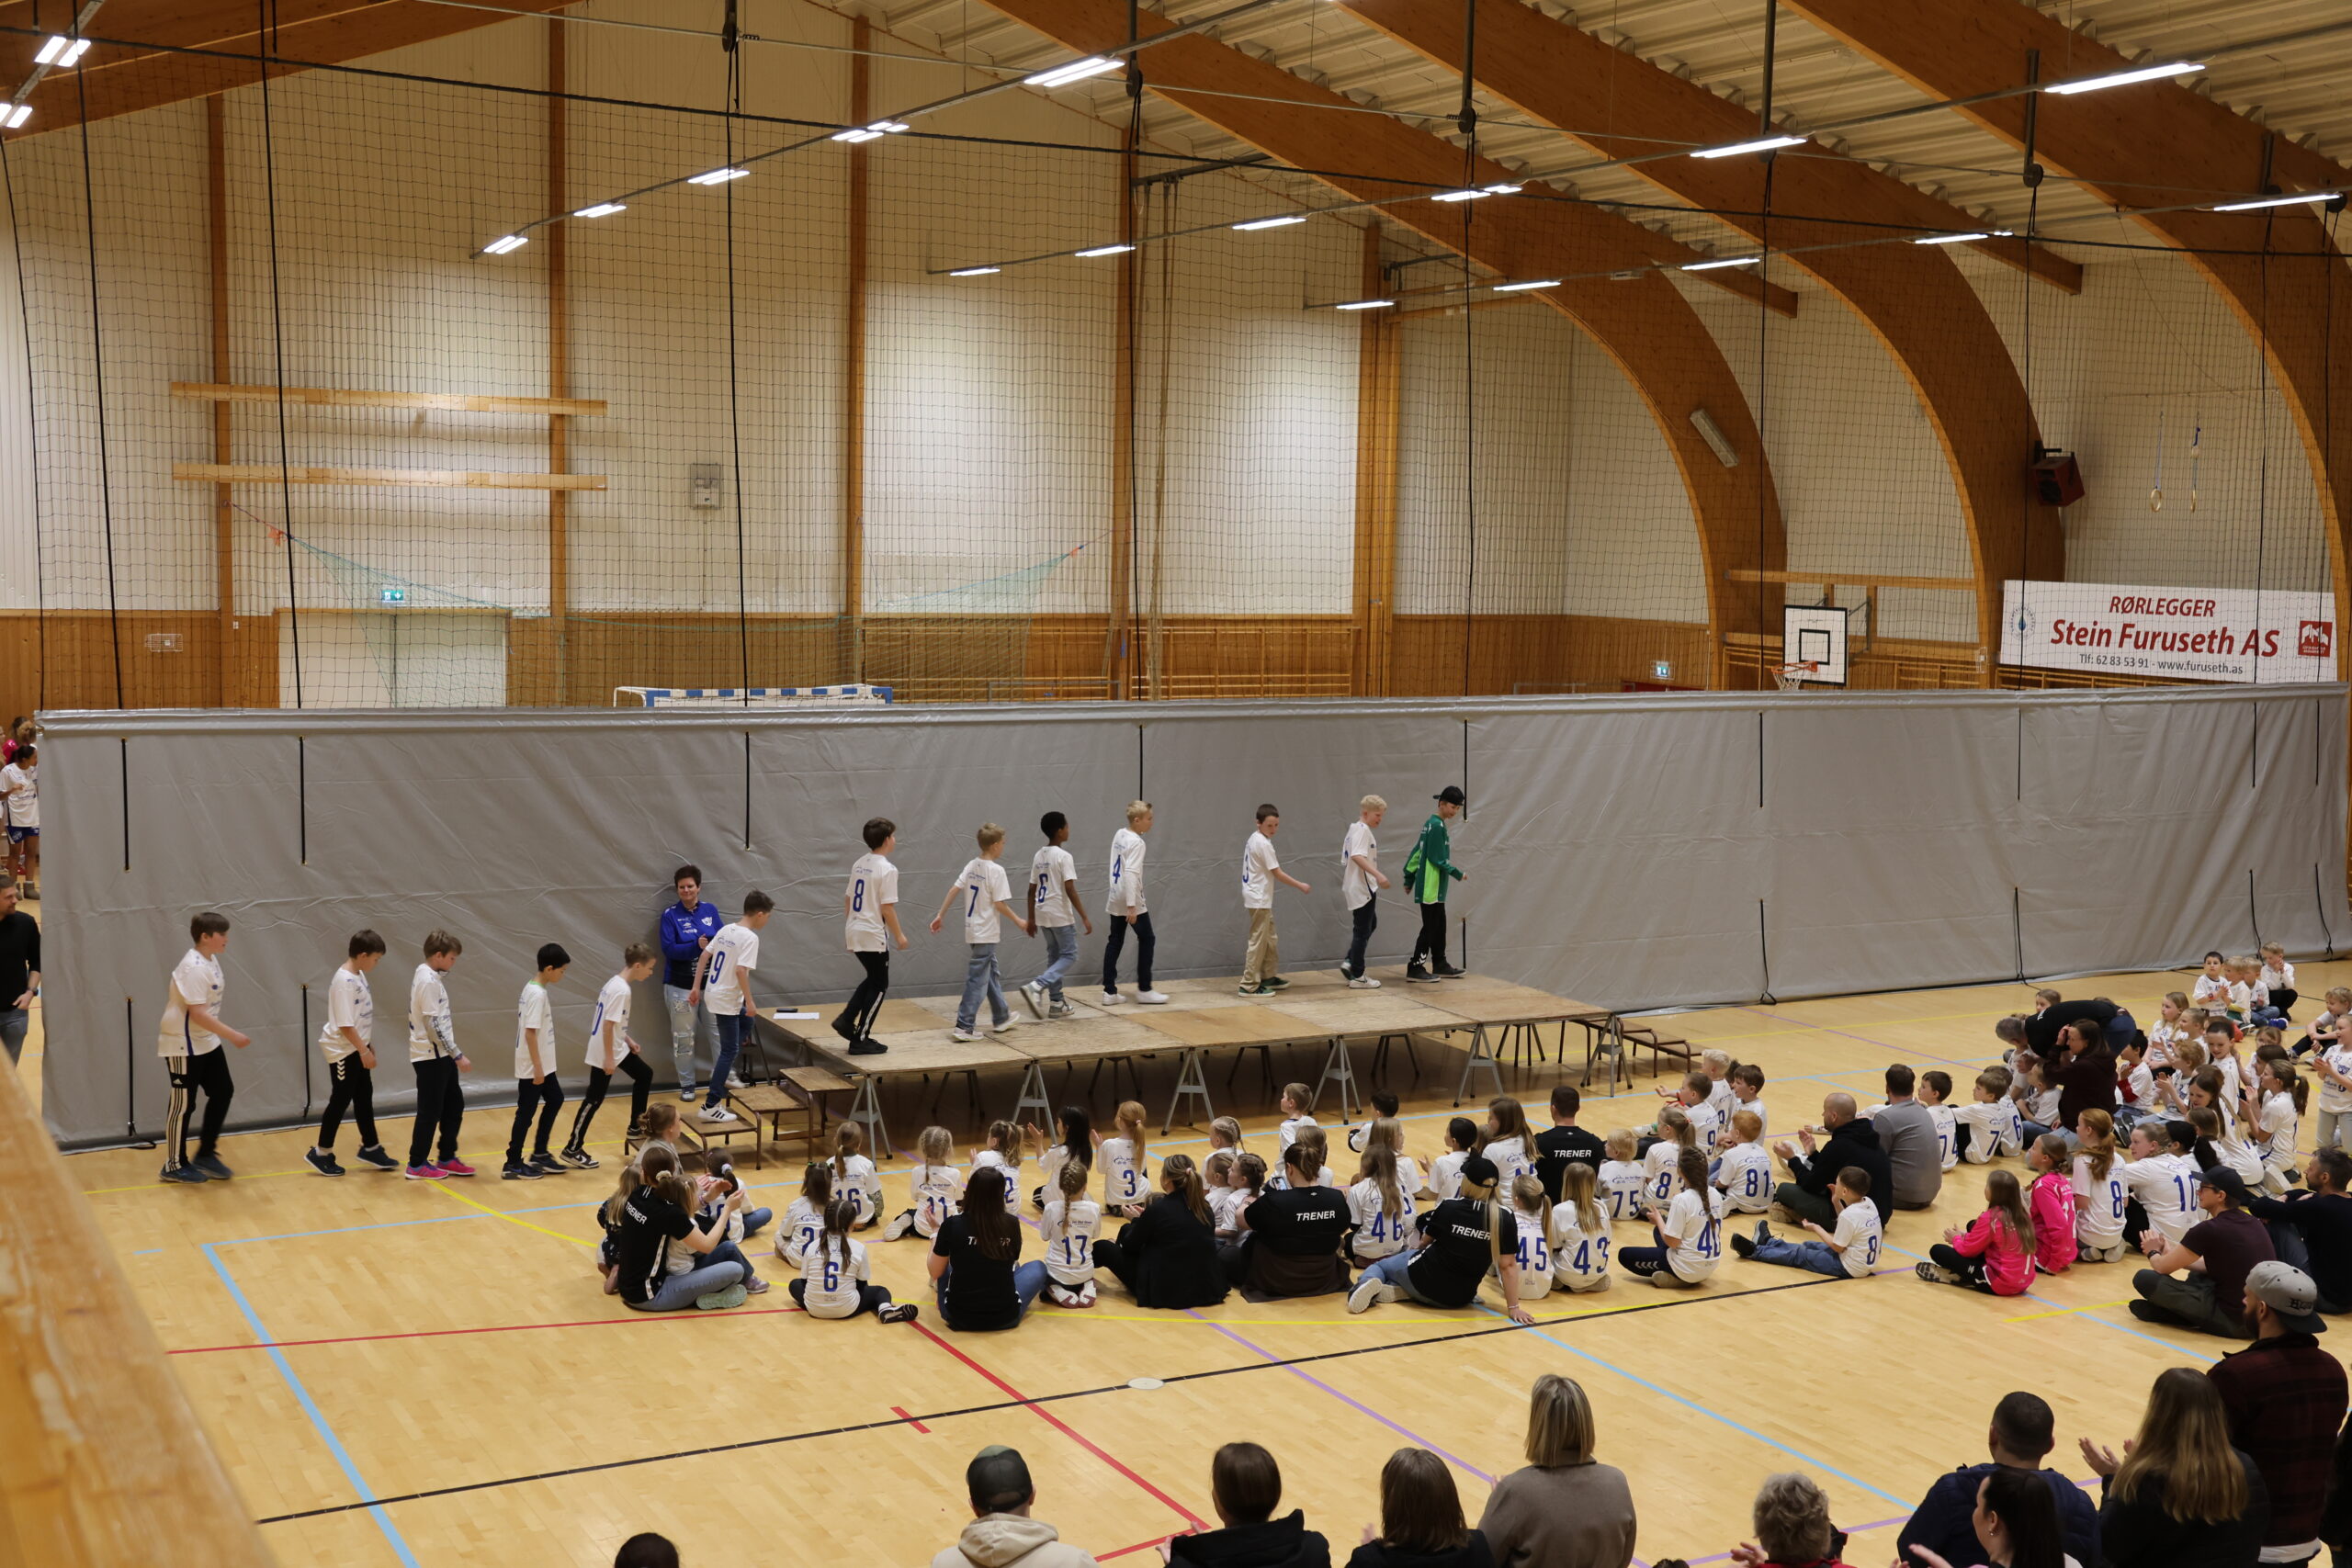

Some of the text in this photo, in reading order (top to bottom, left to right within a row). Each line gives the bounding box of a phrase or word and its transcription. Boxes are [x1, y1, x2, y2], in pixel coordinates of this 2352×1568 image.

[2109, 595, 2216, 617] RØRLEGGER
[2051, 619, 2112, 646] Stein
[2118, 623, 2234, 655] Furuseth
[2240, 629, 2280, 658] AS
[2079, 653, 2095, 665] Tlf:
[2096, 655, 2108, 666] 62
[2109, 656, 2121, 667] 83
[2123, 657, 2136, 668] 53
[2138, 658, 2150, 669] 91
[2157, 660, 2244, 675] www.furuseth.as
[1113, 854, 1121, 885] 4
[853, 878, 865, 912] 8
[967, 885, 979, 918] 7
[1038, 873, 1048, 903] 6
[709, 951, 726, 985] 9
[1707, 1130, 1715, 1156] 9
[2013, 1114, 2022, 1142] 6
[1554, 1149, 1592, 1158] TRENER
[1123, 1169, 1136, 1197] 3
[1746, 1168, 1770, 1198] 81
[2173, 1175, 2198, 1212] 10
[626, 1201, 647, 1225] TRENER
[1612, 1190, 1640, 1218] 75
[2110, 1180, 2123, 1218] 8
[1295, 1210, 1336, 1222] TRENER
[1371, 1211, 1404, 1244] 46
[1452, 1224, 1491, 1241] TRENER
[1061, 1235, 1088, 1265] 17
[1515, 1236, 1547, 1271] 45
[1572, 1236, 1610, 1276] 43
[823, 1261, 839, 1292] 6
